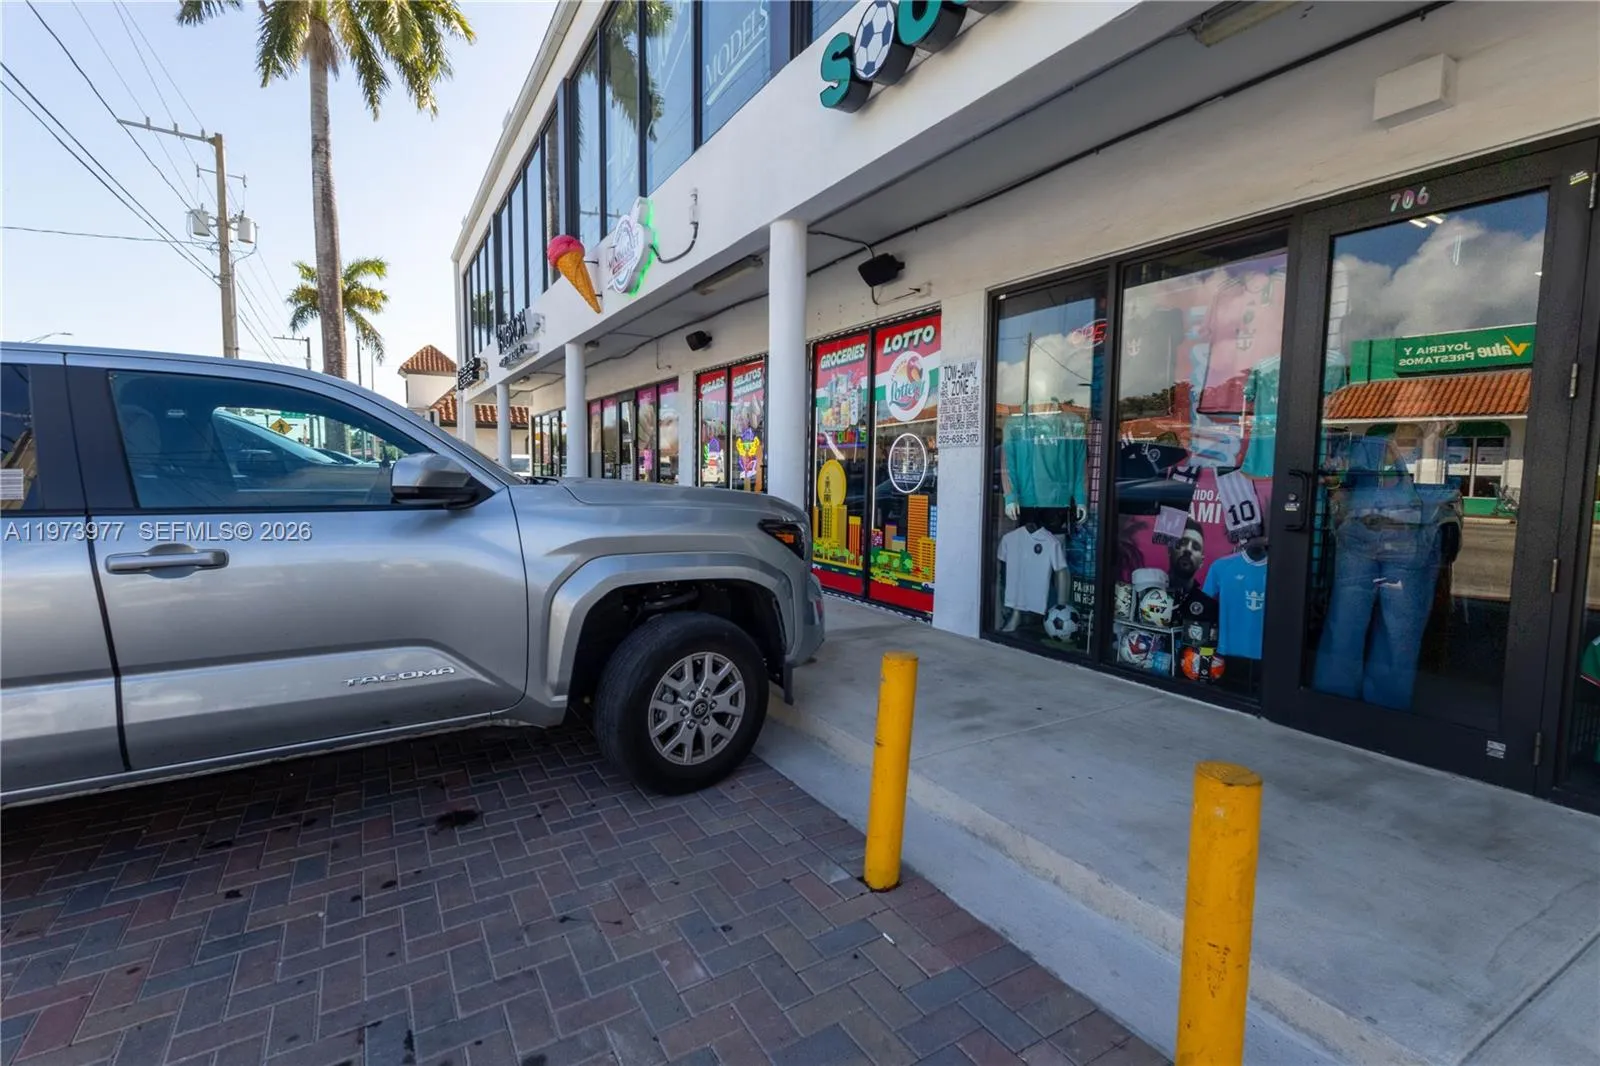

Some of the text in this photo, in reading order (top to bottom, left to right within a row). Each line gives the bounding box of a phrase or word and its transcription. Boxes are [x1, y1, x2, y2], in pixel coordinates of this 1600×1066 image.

[705, 0, 768, 90] MODELS
[1390, 186, 1429, 212] 706
[883, 325, 936, 355] LOTTO
[820, 343, 866, 370] GROCERIES
[951, 379, 969, 396] ZONE
[1228, 500, 1255, 526] 10
[343, 666, 455, 687] TACOMA
